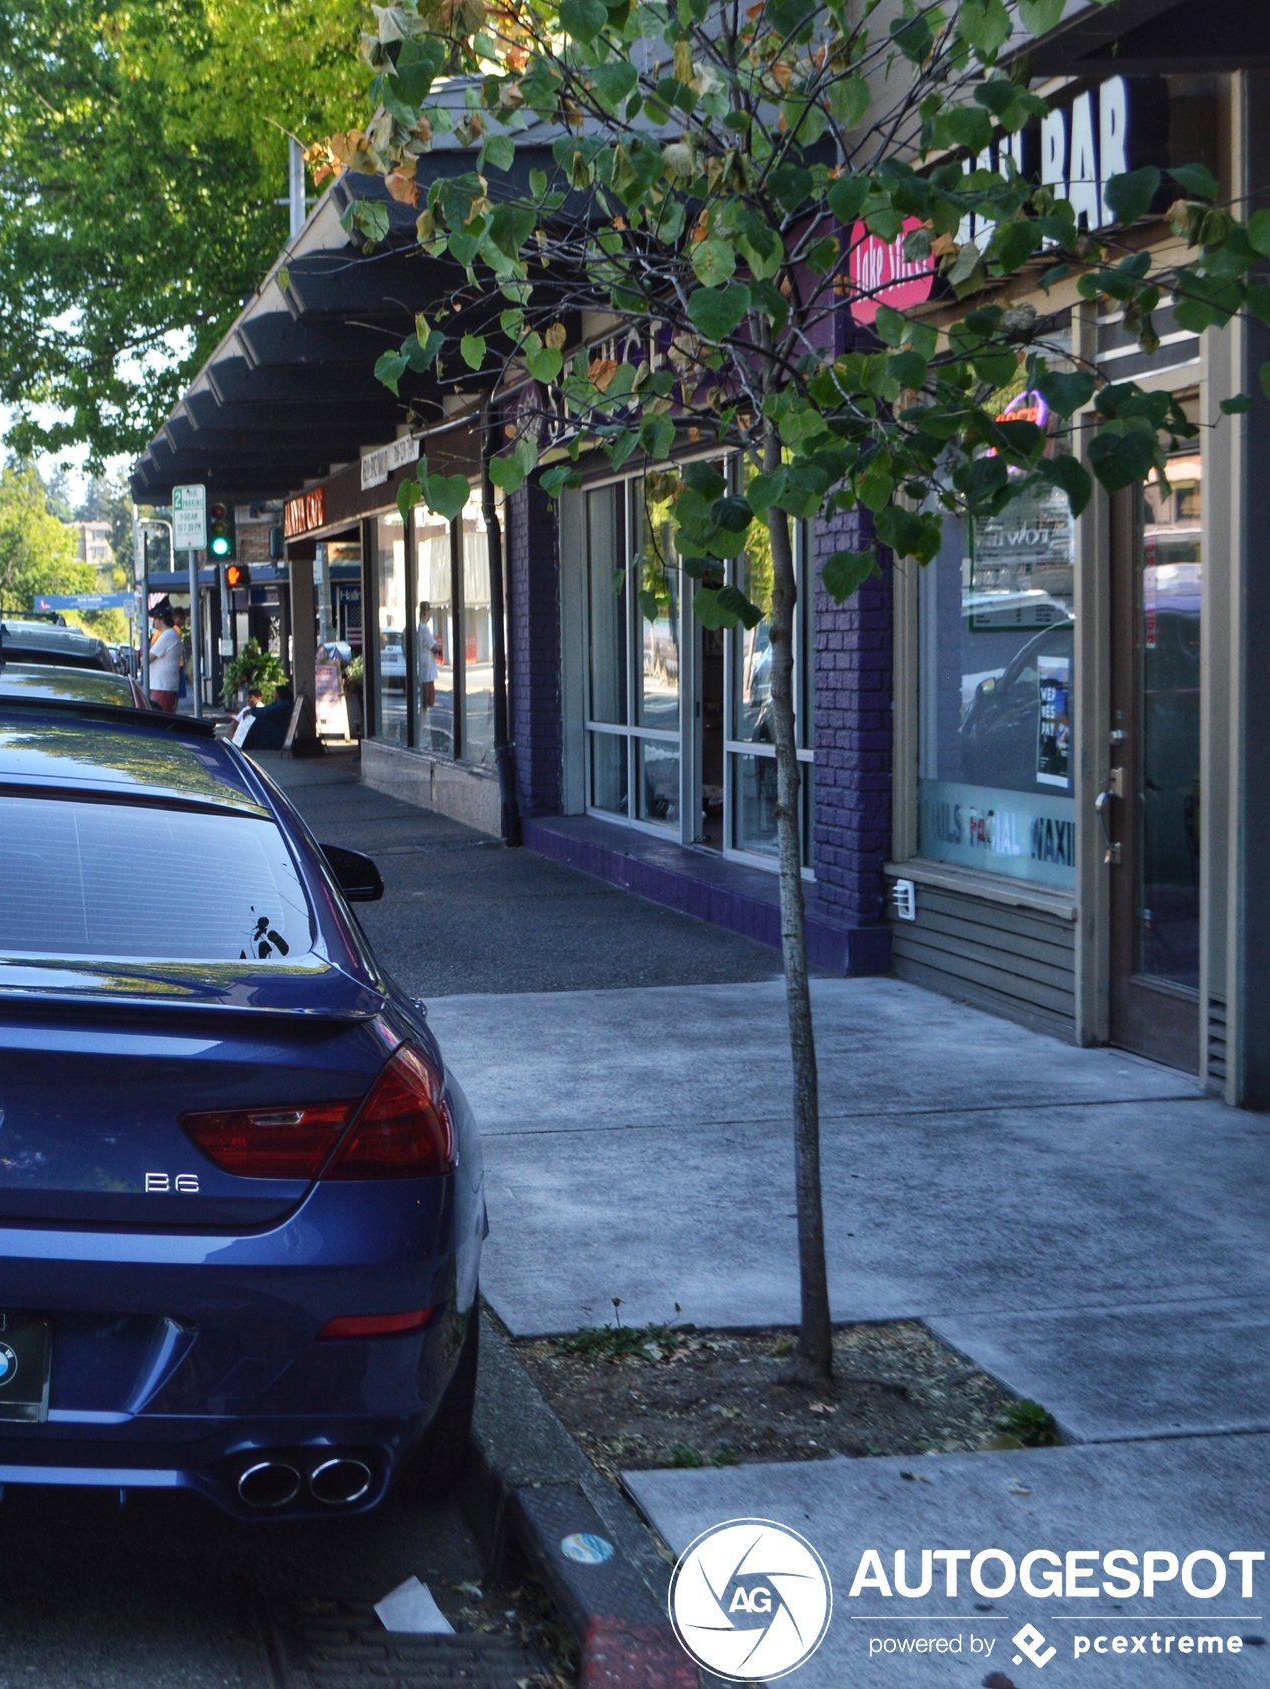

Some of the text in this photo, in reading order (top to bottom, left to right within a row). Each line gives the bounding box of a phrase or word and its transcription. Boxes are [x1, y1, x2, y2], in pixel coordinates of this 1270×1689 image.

[1041, 74, 1128, 251] BAR
[174, 491, 182, 508] 2
[144, 1172, 200, 1194] B6
